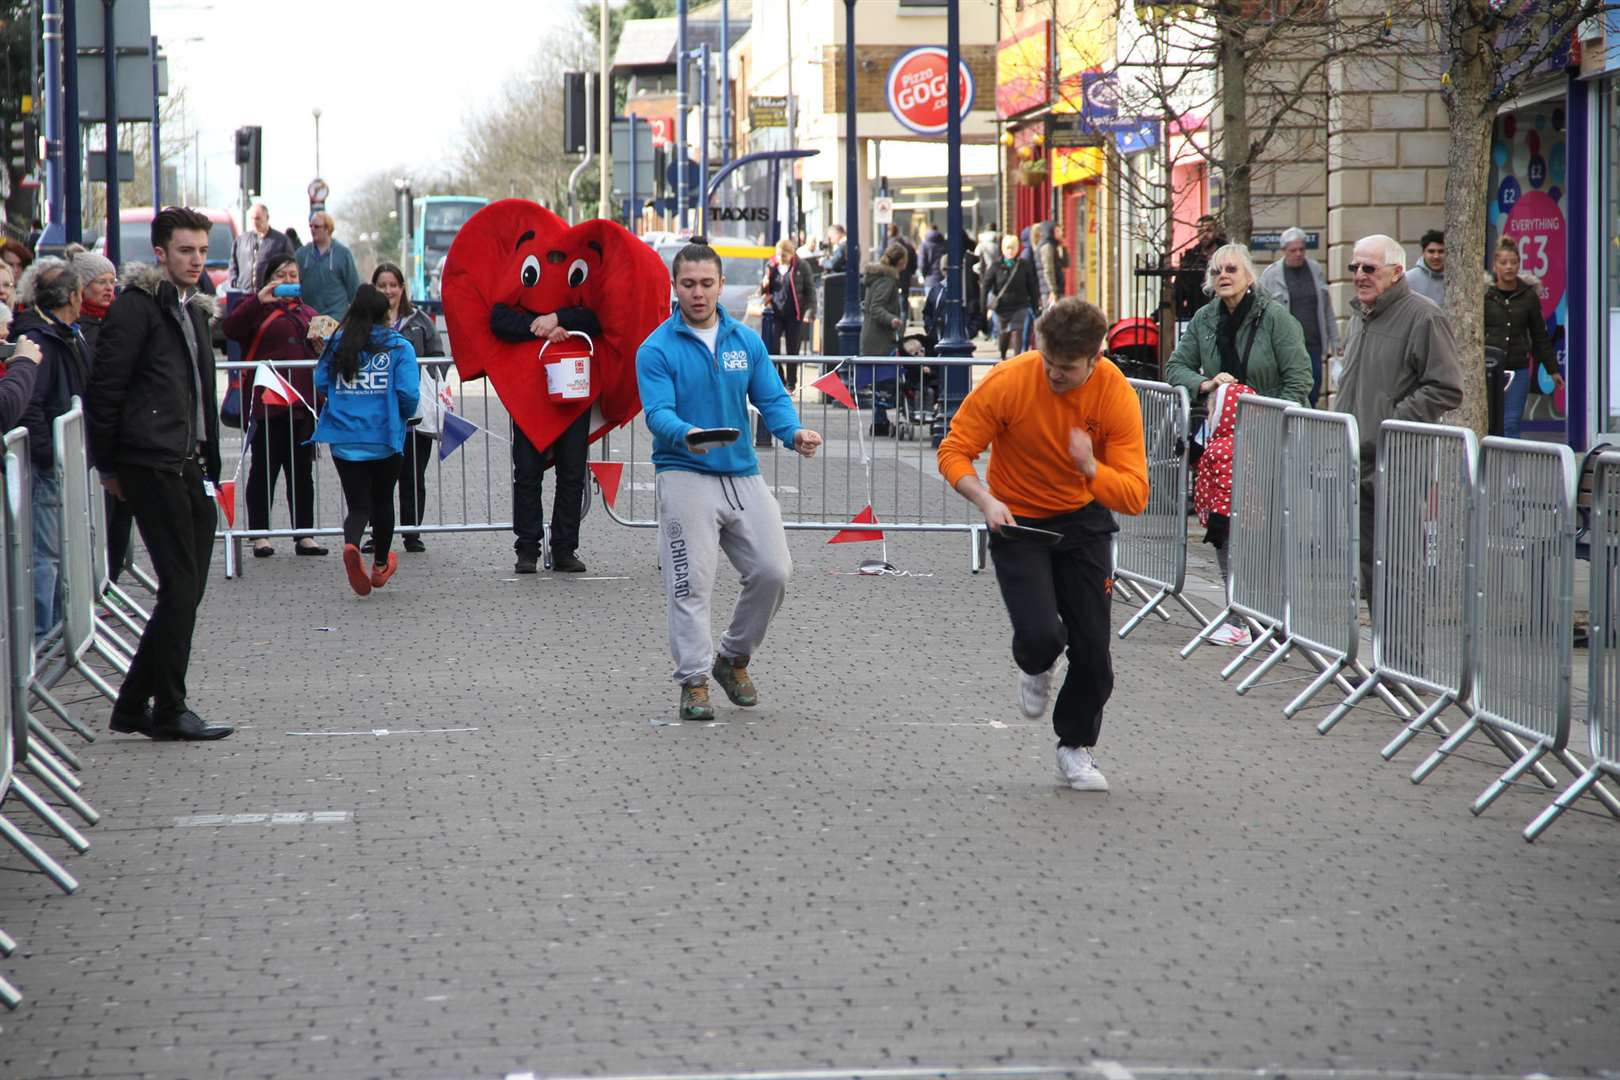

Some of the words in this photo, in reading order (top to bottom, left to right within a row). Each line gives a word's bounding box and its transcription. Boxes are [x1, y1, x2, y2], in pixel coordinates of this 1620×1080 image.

[898, 72, 962, 110] GOG
[932, 97, 950, 112] .co
[1531, 164, 1543, 178] £2
[1503, 189, 1516, 204] £2
[708, 207, 769, 221] TAXIS
[1511, 217, 1560, 231] EVERYTHING
[1519, 235, 1549, 279] £3
[724, 359, 748, 369] NRG
[335, 371, 389, 390] NRG
[670, 539, 690, 599] CHICAGO
